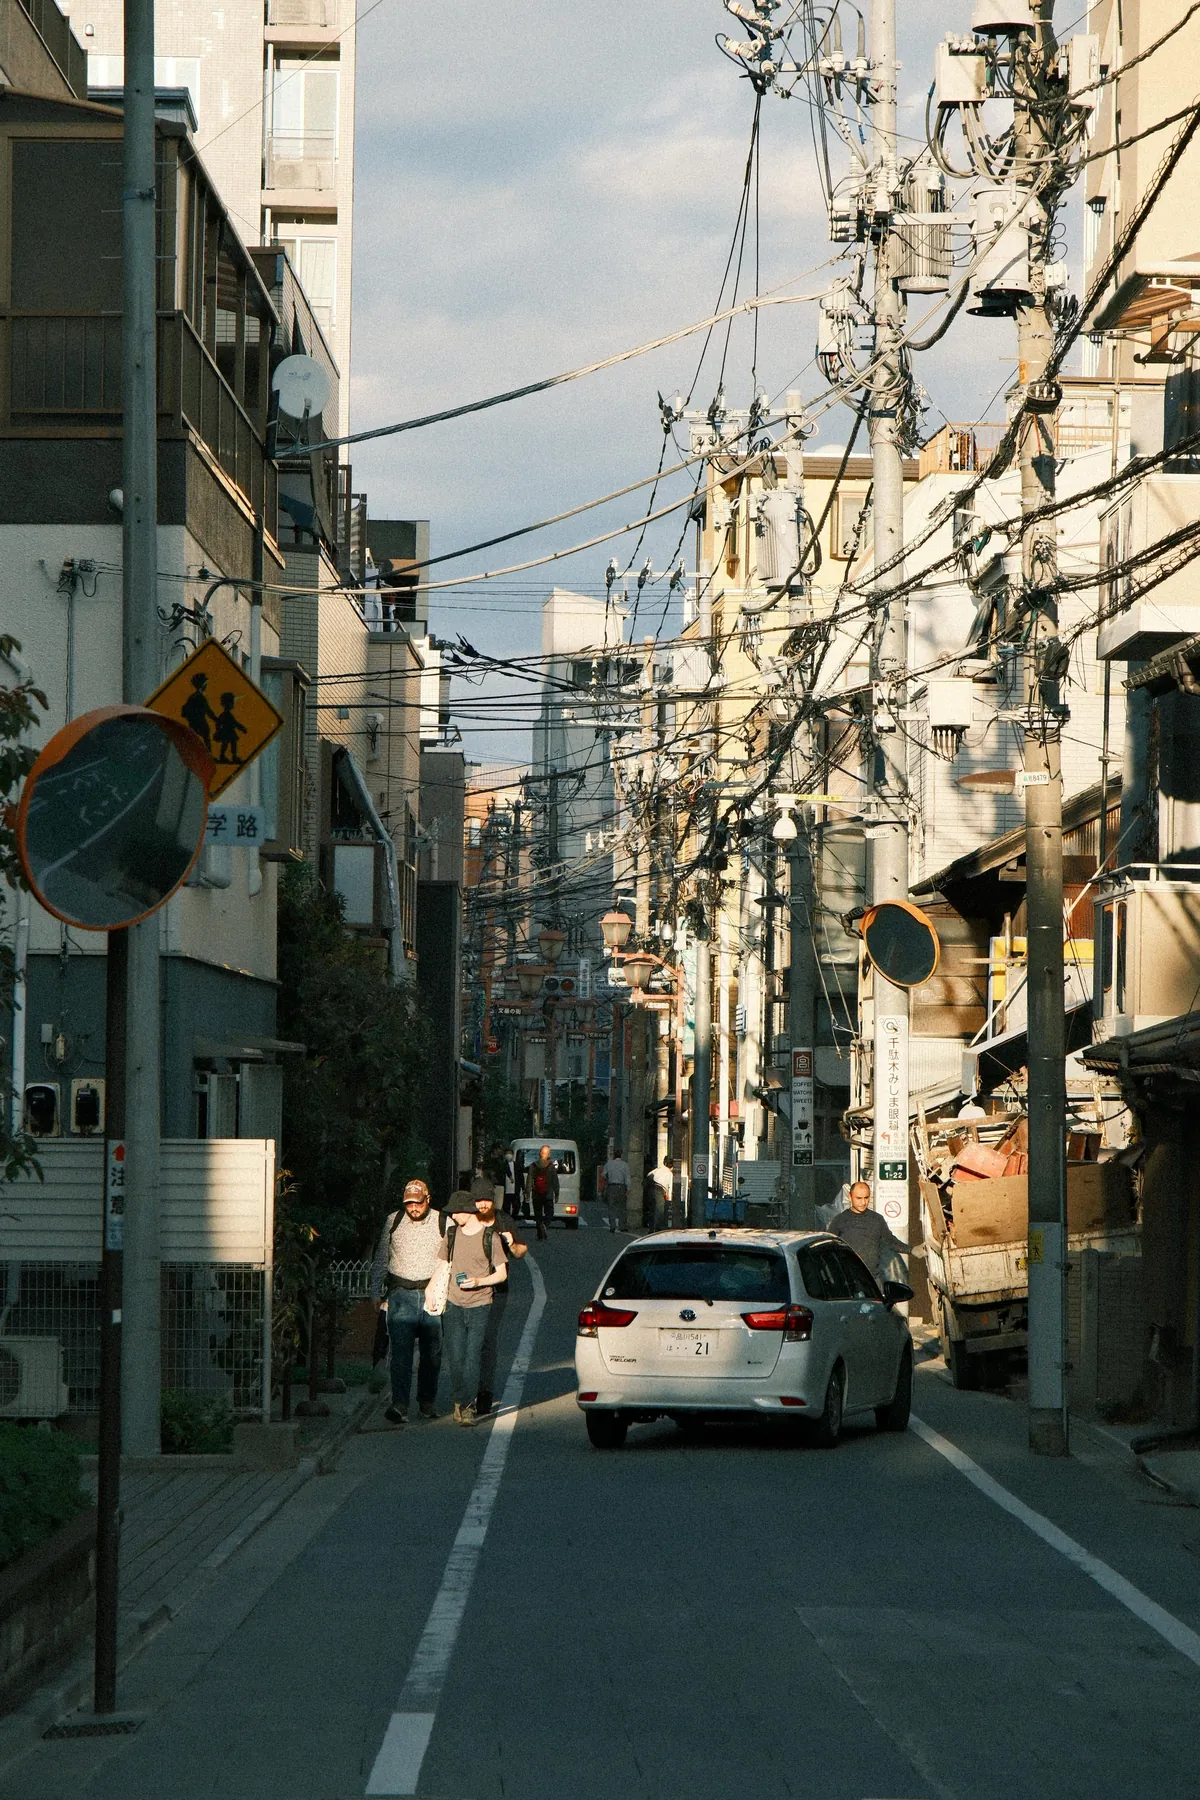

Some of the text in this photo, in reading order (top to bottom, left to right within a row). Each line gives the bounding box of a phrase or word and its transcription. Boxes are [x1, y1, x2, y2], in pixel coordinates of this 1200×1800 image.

[888, 1037, 900, 1131] 千駄木みしま眼科
